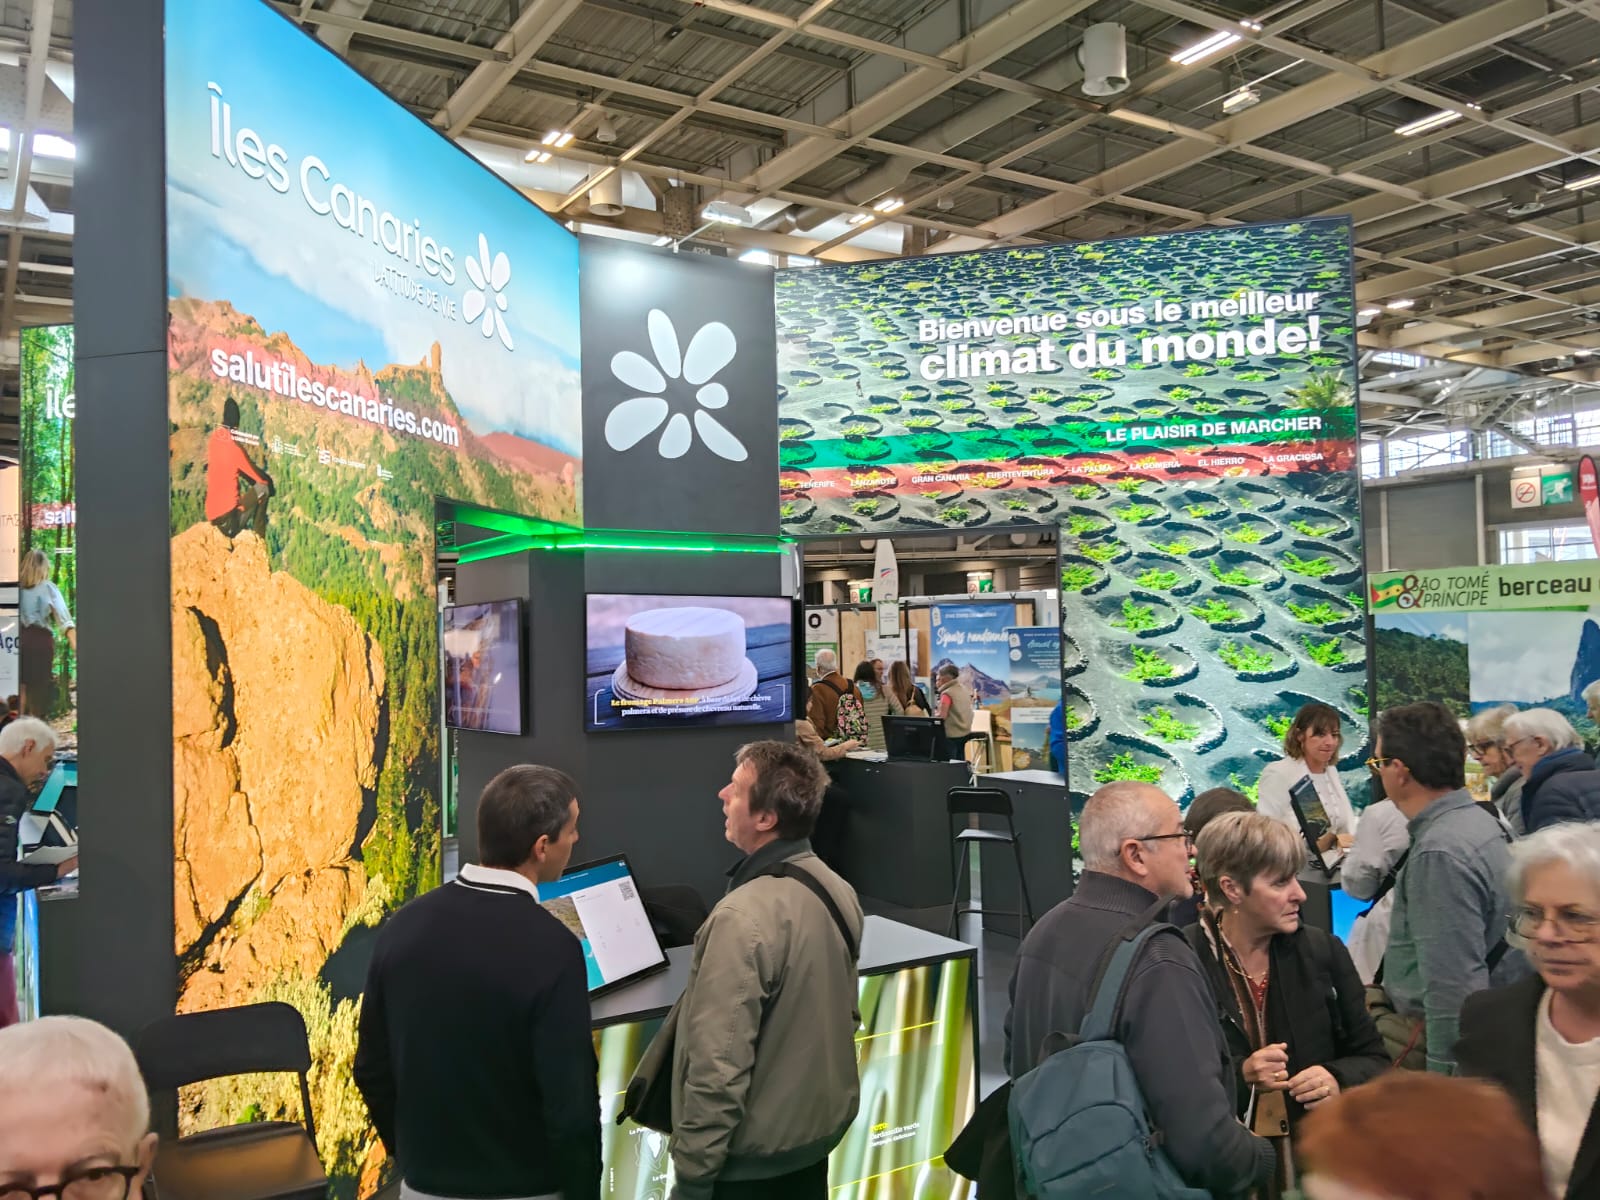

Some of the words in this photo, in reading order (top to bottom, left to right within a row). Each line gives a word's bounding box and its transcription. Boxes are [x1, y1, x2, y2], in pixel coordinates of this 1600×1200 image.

[207, 80, 290, 194] Îles
[300, 155, 457, 286] Canaries
[440, 295, 457, 321] VIE
[919, 312, 1068, 342] Bienvenue
[1076, 305, 1146, 329] sous
[1155, 299, 1182, 323] le
[1191, 290, 1319, 320] meilleur
[920, 338, 1056, 381] climat
[1068, 331, 1126, 370] du
[1141, 315, 1321, 365] monde!
[211, 348, 460, 448] salutîlescanaries.com
[1106, 428, 1127, 442] LE
[1131, 424, 1198, 441] PLAISIR
[1201, 421, 1228, 436] DE
[1230, 416, 1322, 435] MARCHER
[800, 480, 836, 489] TENERIFE
[850, 477, 897, 487] LANZAROTE
[912, 475, 933, 484] GRAN
[934, 473, 970, 482] CANARIA
[986, 468, 1055, 479] FUERTEVENTURA
[1071, 466, 1083, 474] LA
[1084, 464, 1113, 473] PALMA
[1129, 463, 1142, 471] LA
[1143, 460, 1181, 470] GOMERA
[1197, 459, 1209, 467] EL
[1211, 457, 1245, 466] HIERRO
[1262, 455, 1275, 463] LA
[1276, 453, 1324, 463] GRACIOSA
[1447, 570, 1490, 590] TOMÉ
[1498, 576, 1592, 597] berceau
[621, 698, 652, 707] fromage
